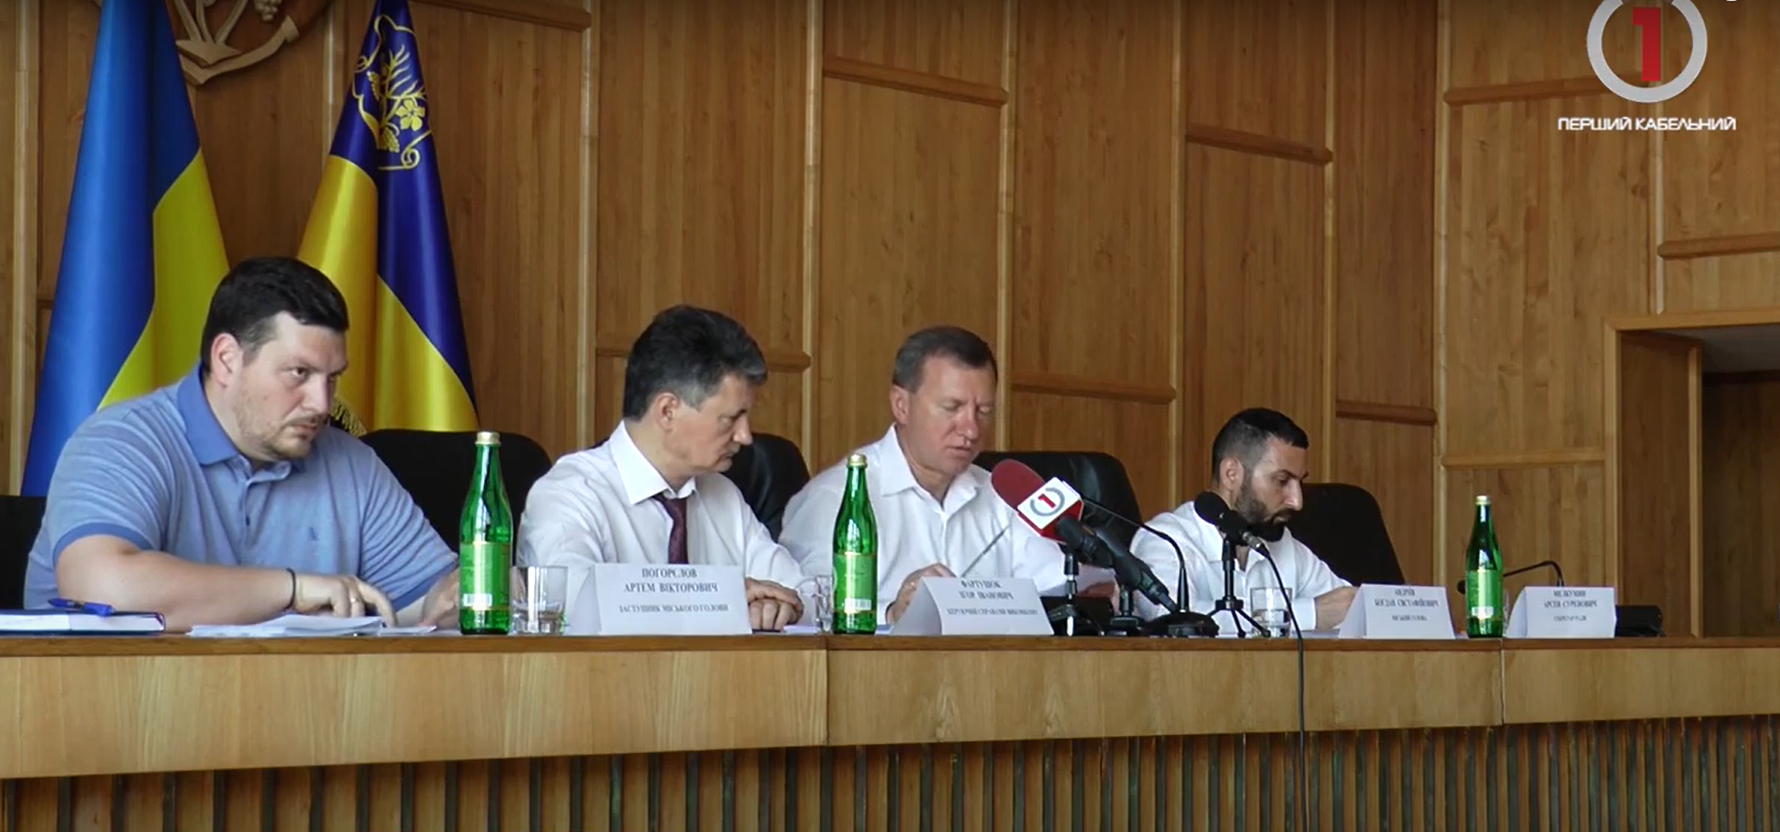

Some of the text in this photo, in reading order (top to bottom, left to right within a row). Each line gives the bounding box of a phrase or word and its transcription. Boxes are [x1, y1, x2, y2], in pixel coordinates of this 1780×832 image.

[1037, 493, 1057, 509] 1
[623, 582, 718, 593] АРТЕМ ВІКТОРОВИЧ
